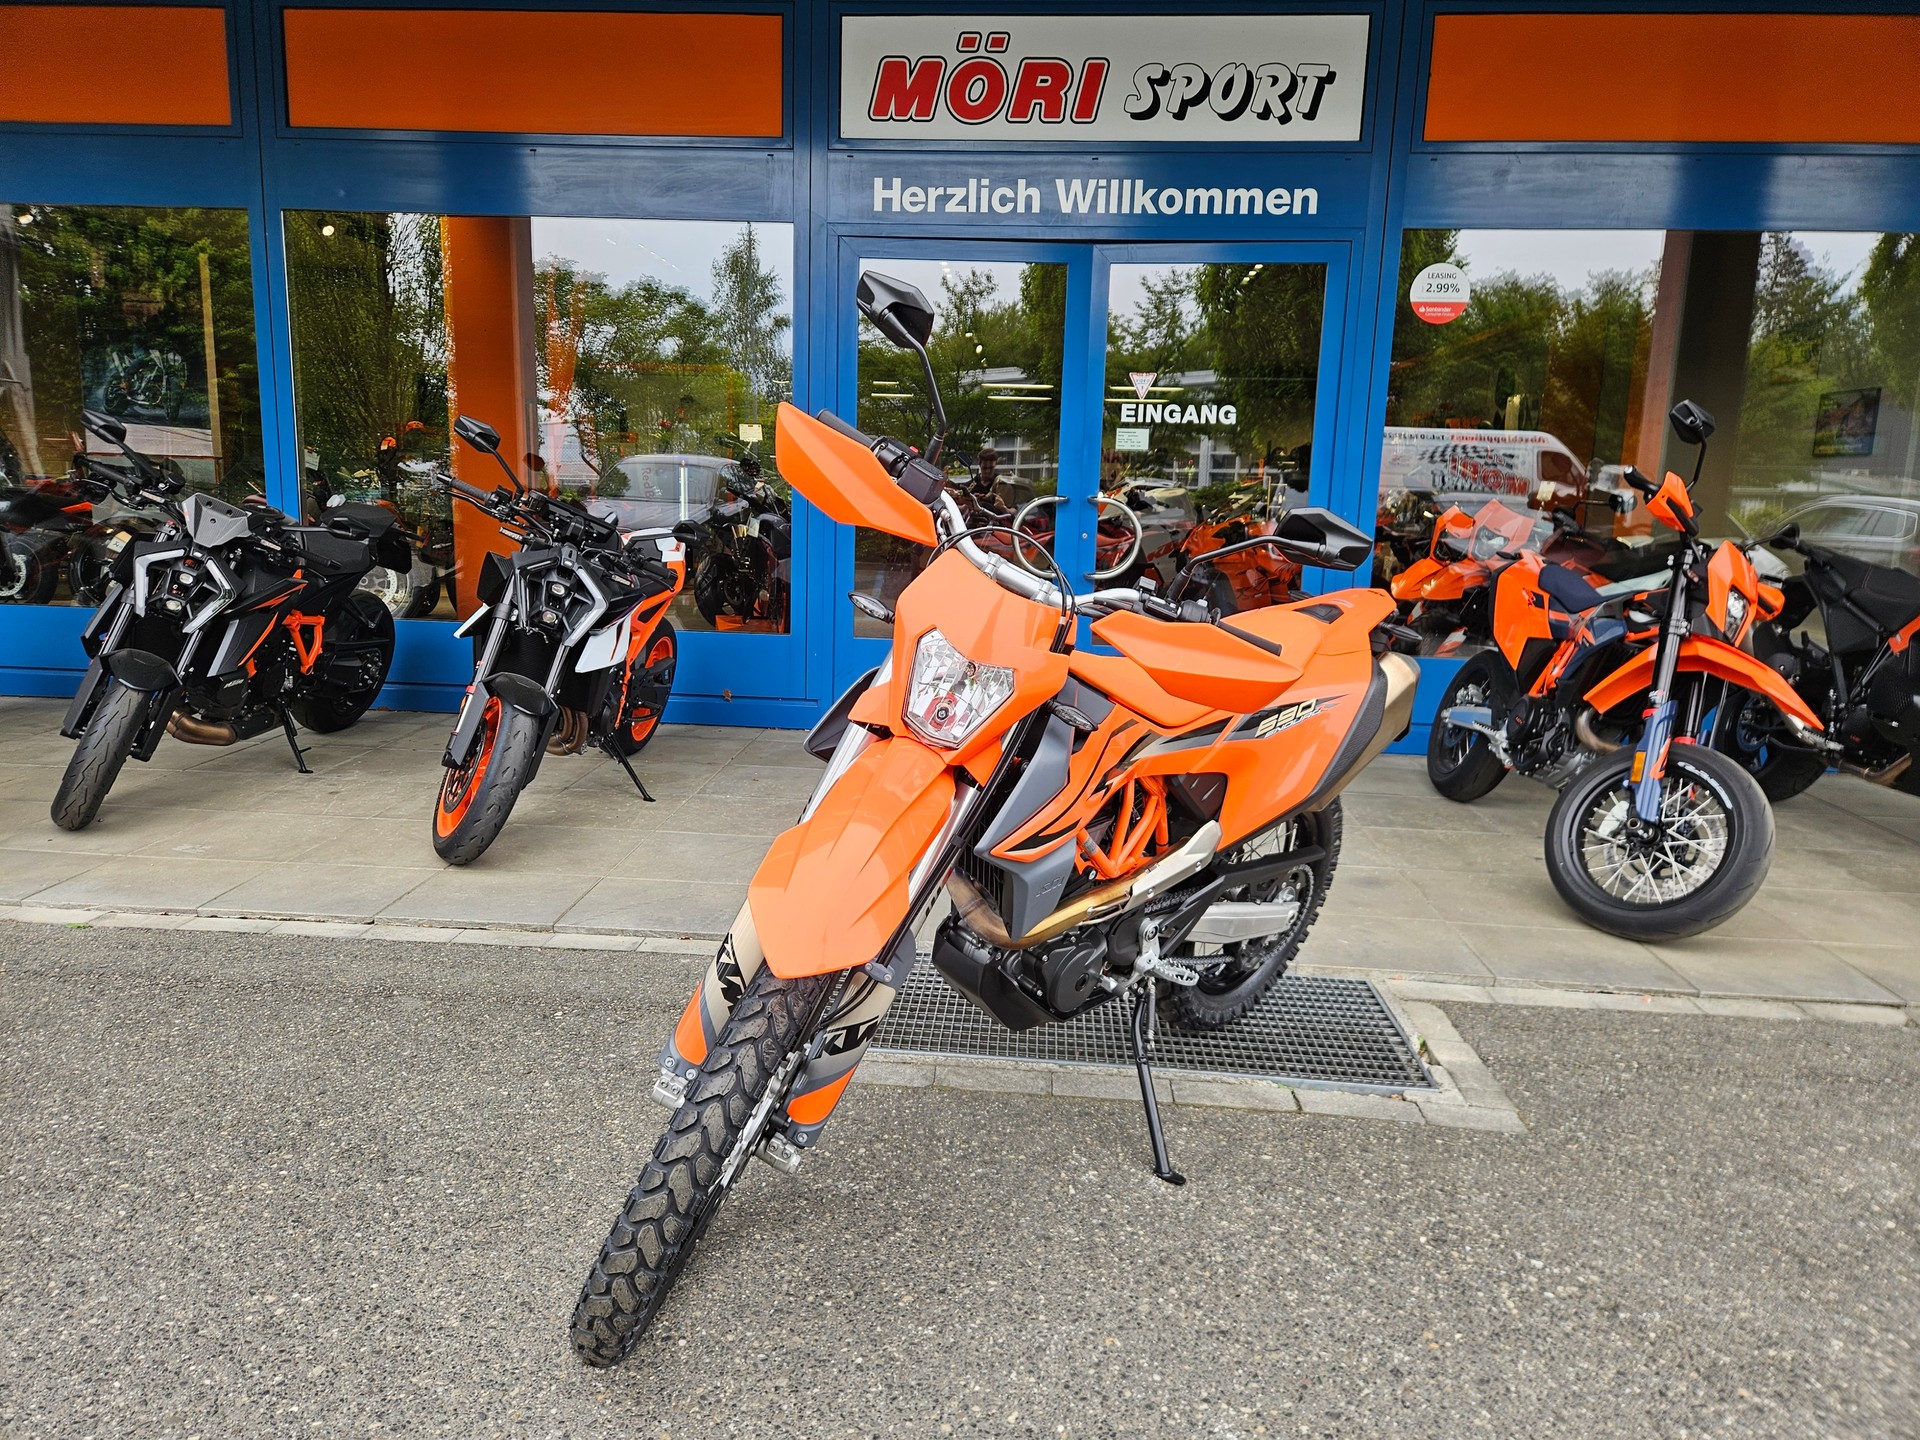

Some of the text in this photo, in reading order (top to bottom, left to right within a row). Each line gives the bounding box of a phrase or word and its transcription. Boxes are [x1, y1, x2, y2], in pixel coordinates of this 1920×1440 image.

[868, 31, 1336, 125] MÖRI SPORT
[873, 176, 1319, 216] Herzlich Willkommen
[1426, 283, 1460, 293] 2.99%
[1120, 403, 1237, 425] EINGANG
[1254, 698, 1317, 738] 690
